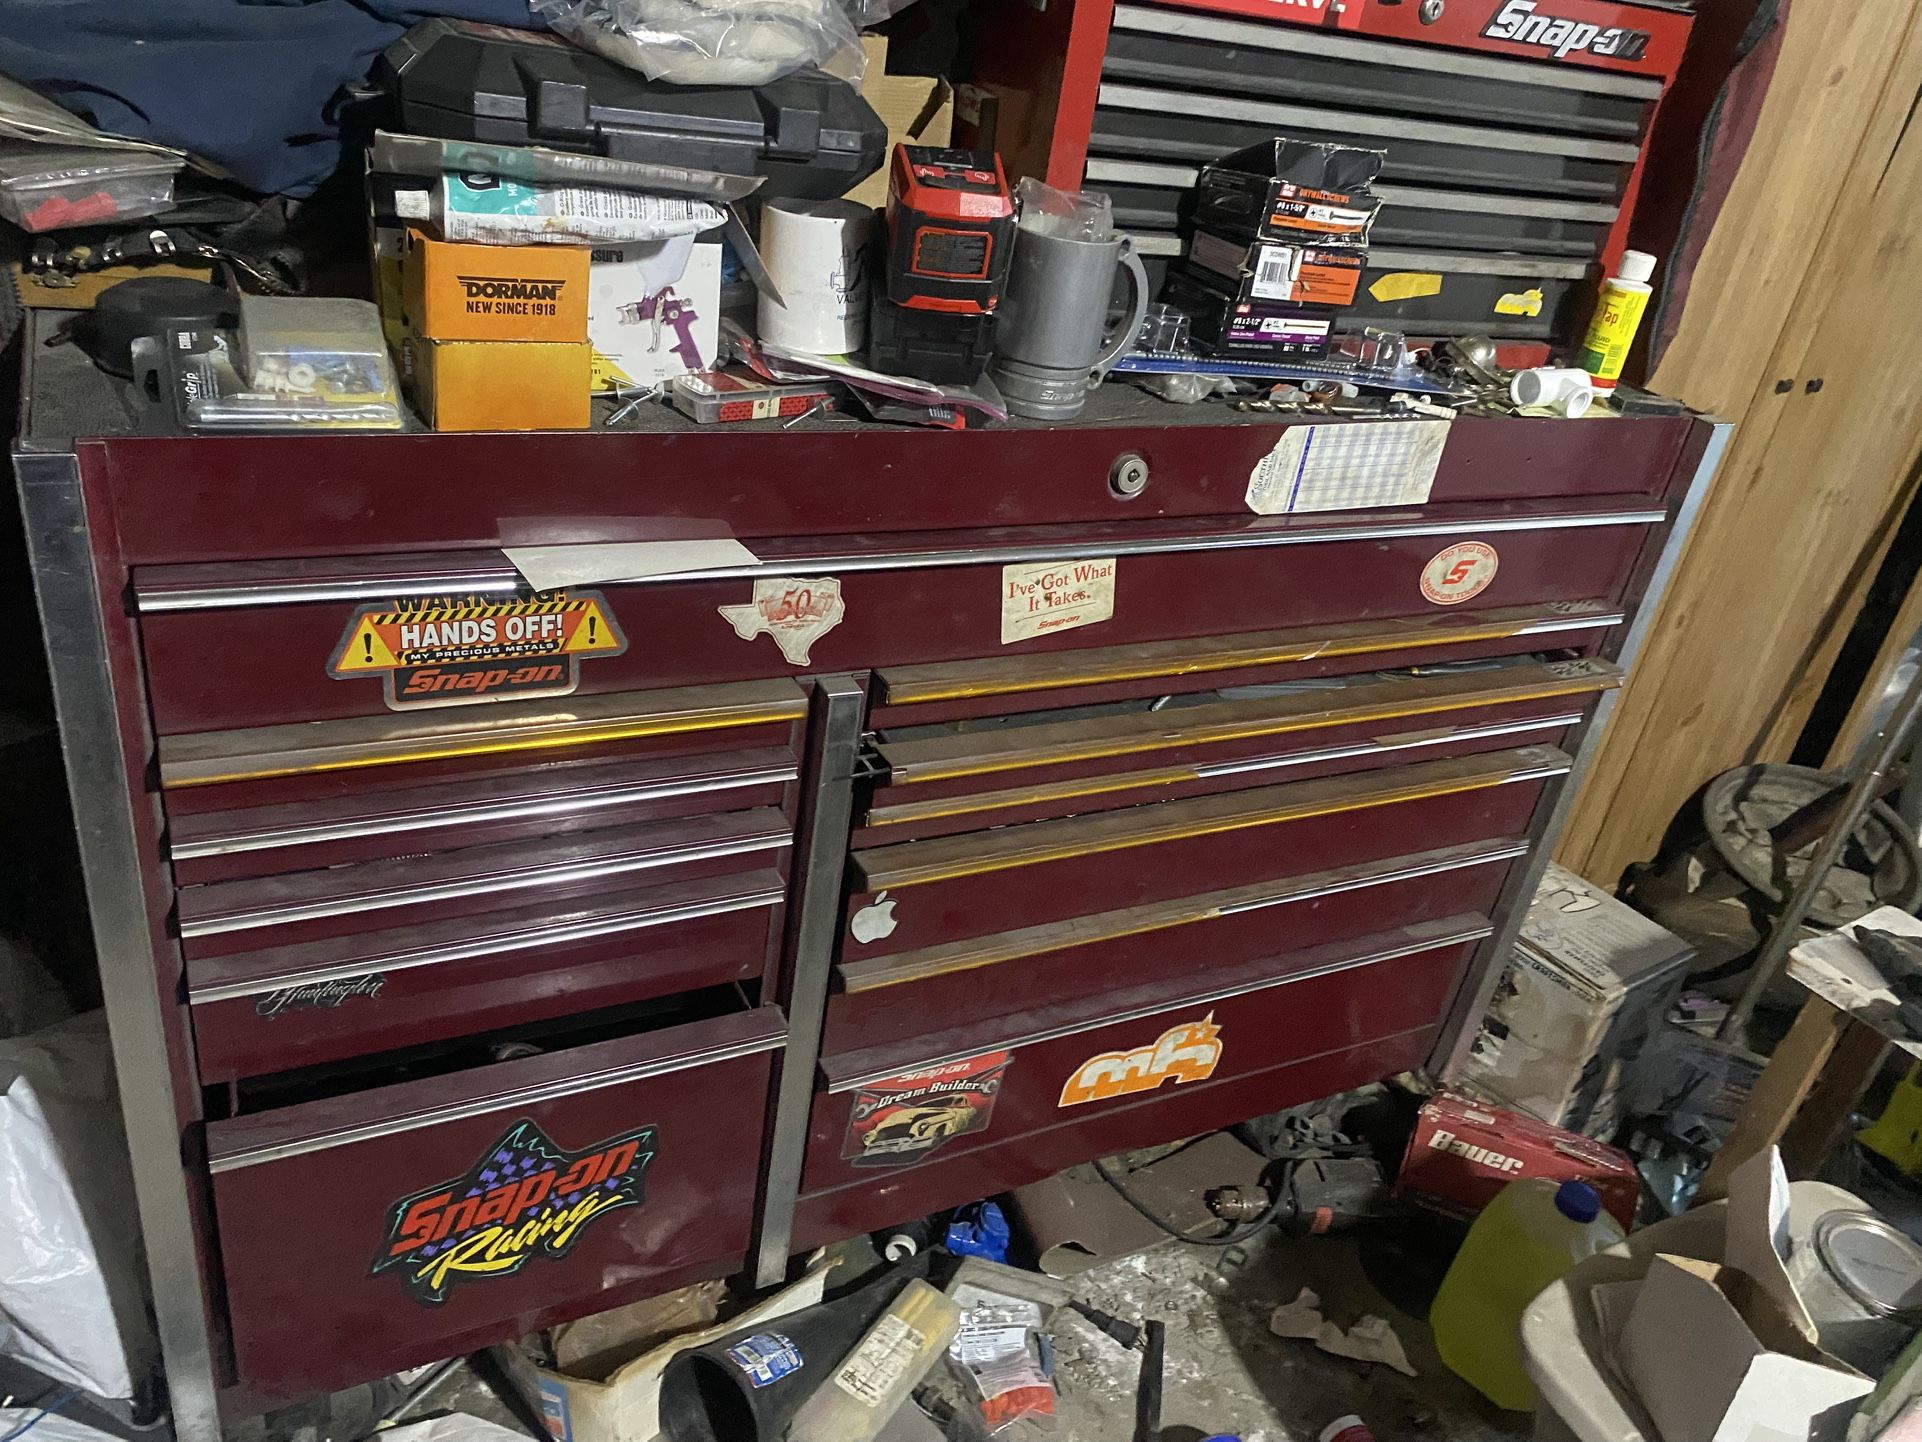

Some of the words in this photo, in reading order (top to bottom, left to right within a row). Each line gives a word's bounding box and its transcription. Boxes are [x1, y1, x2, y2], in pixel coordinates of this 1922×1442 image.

[466, 281, 558, 300] DORMAN
[466, 302, 493, 314] NEW
[495, 302, 528, 316] SINCE
[531, 302, 556, 316] 1918
[1008, 581, 1036, 599] I've
[1041, 573, 1069, 591] Got
[1073, 564, 1112, 583] What
[780, 587, 812, 620] 50
[1028, 596, 1041, 612] It
[401, 619, 497, 649] HANDS
[505, 613, 563, 641] OFF!
[1037, 615, 1081, 630] Snap-on
[410, 652, 424, 661] MY
[435, 646, 498, 658] PRECIOUS
[506, 642, 554, 652] METALS
[403, 664, 562, 694] Snap-on
[877, 1087, 926, 1108] Dream
[929, 1079, 981, 1094] Builder
[1427, 1129, 1524, 1174] Bauer
[389, 1140, 640, 1256] Snap-on
[417, 1191, 624, 1290] Racing
